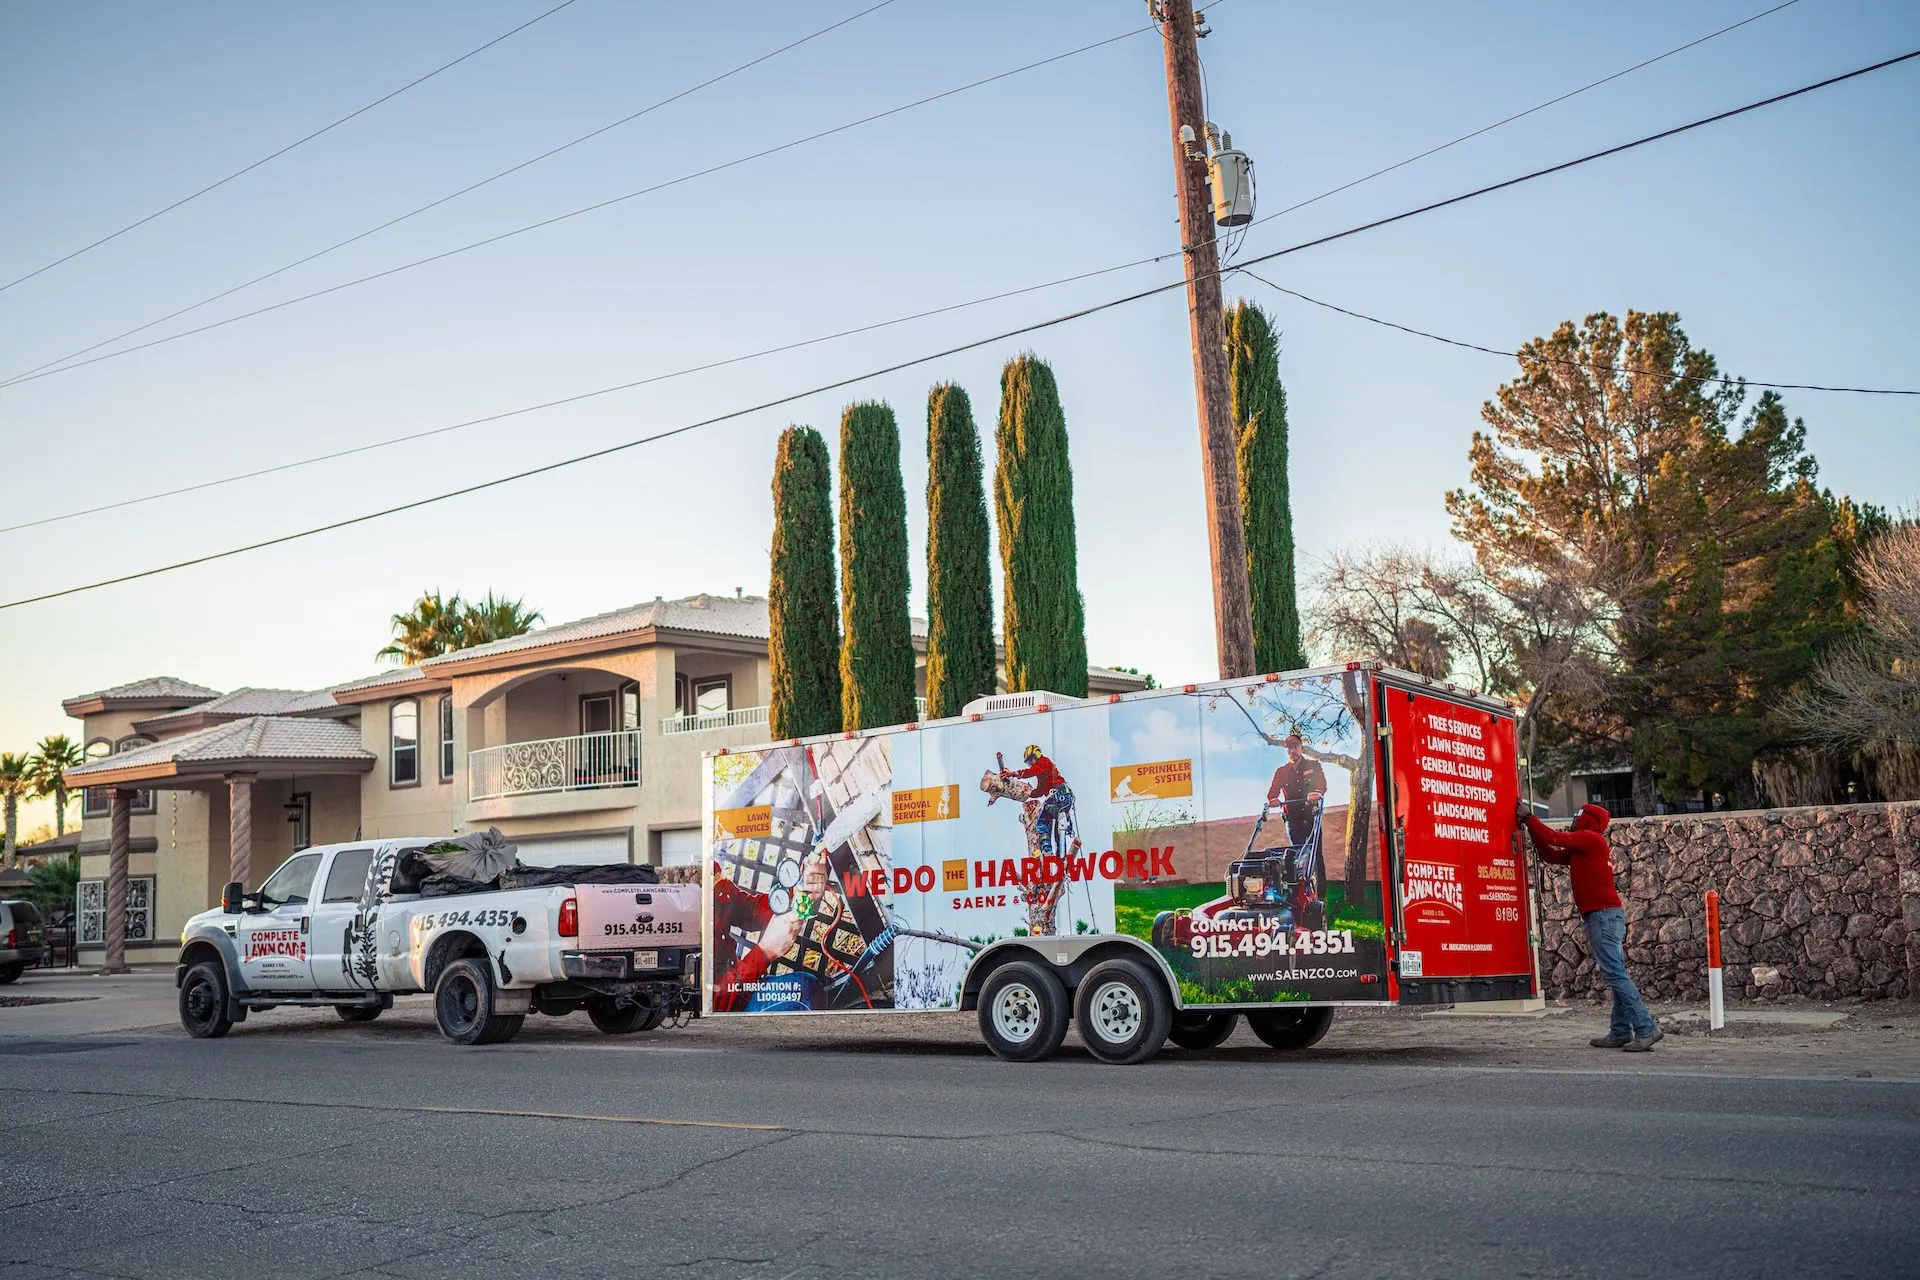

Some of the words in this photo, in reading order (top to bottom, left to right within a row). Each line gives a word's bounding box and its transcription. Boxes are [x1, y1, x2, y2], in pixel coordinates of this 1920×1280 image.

[1428, 714, 1448, 732] TREE
[1448, 719, 1482, 740] SERVICES
[1427, 736, 1451, 754] LAWN
[1452, 741, 1485, 761] SERVICES
[1137, 762, 1191, 776] SPRINKLER
[1422, 756, 1458, 776] GENERAL
[1458, 763, 1482, 780] CLEAN
[1482, 768, 1492, 782] UP
[1155, 773, 1191, 783] SYSTEM
[894, 792, 913, 802] TREE
[1421, 778, 1465, 798] SPRINKLER
[1465, 785, 1496, 804] SYSTEMS
[894, 800, 931, 811] REMOVAL
[1433, 801, 1487, 822] LANDSCAPING
[747, 812, 769, 822] LAWN
[894, 810, 926, 821] SERVICE
[736, 823, 770, 834] SERVICES
[1434, 823, 1489, 843] MAINTENANCE
[843, 868, 886, 898] WE
[893, 865, 936, 894] DO
[946, 868, 965, 880] THE
[974, 846, 1176, 889] HARDWORK
[1407, 863, 1454, 880] COMPLETE
[1478, 865, 1516, 880] 915.494.4351
[952, 895, 1006, 910] SAENZ
[1013, 896, 1019, 904] &
[605, 922, 683, 935] 915.494.4351
[1190, 918, 1254, 933] CONTACT
[1261, 917, 1280, 931] US
[252, 931, 299, 941] COMPLETE
[1190, 929, 1355, 958] 915.494.4351
[244, 943, 276, 964] LAWN
[727, 983, 741, 992] LIC.
[743, 982, 791, 992] IRRIGATION
[757, 992, 801, 1001] L10018497
